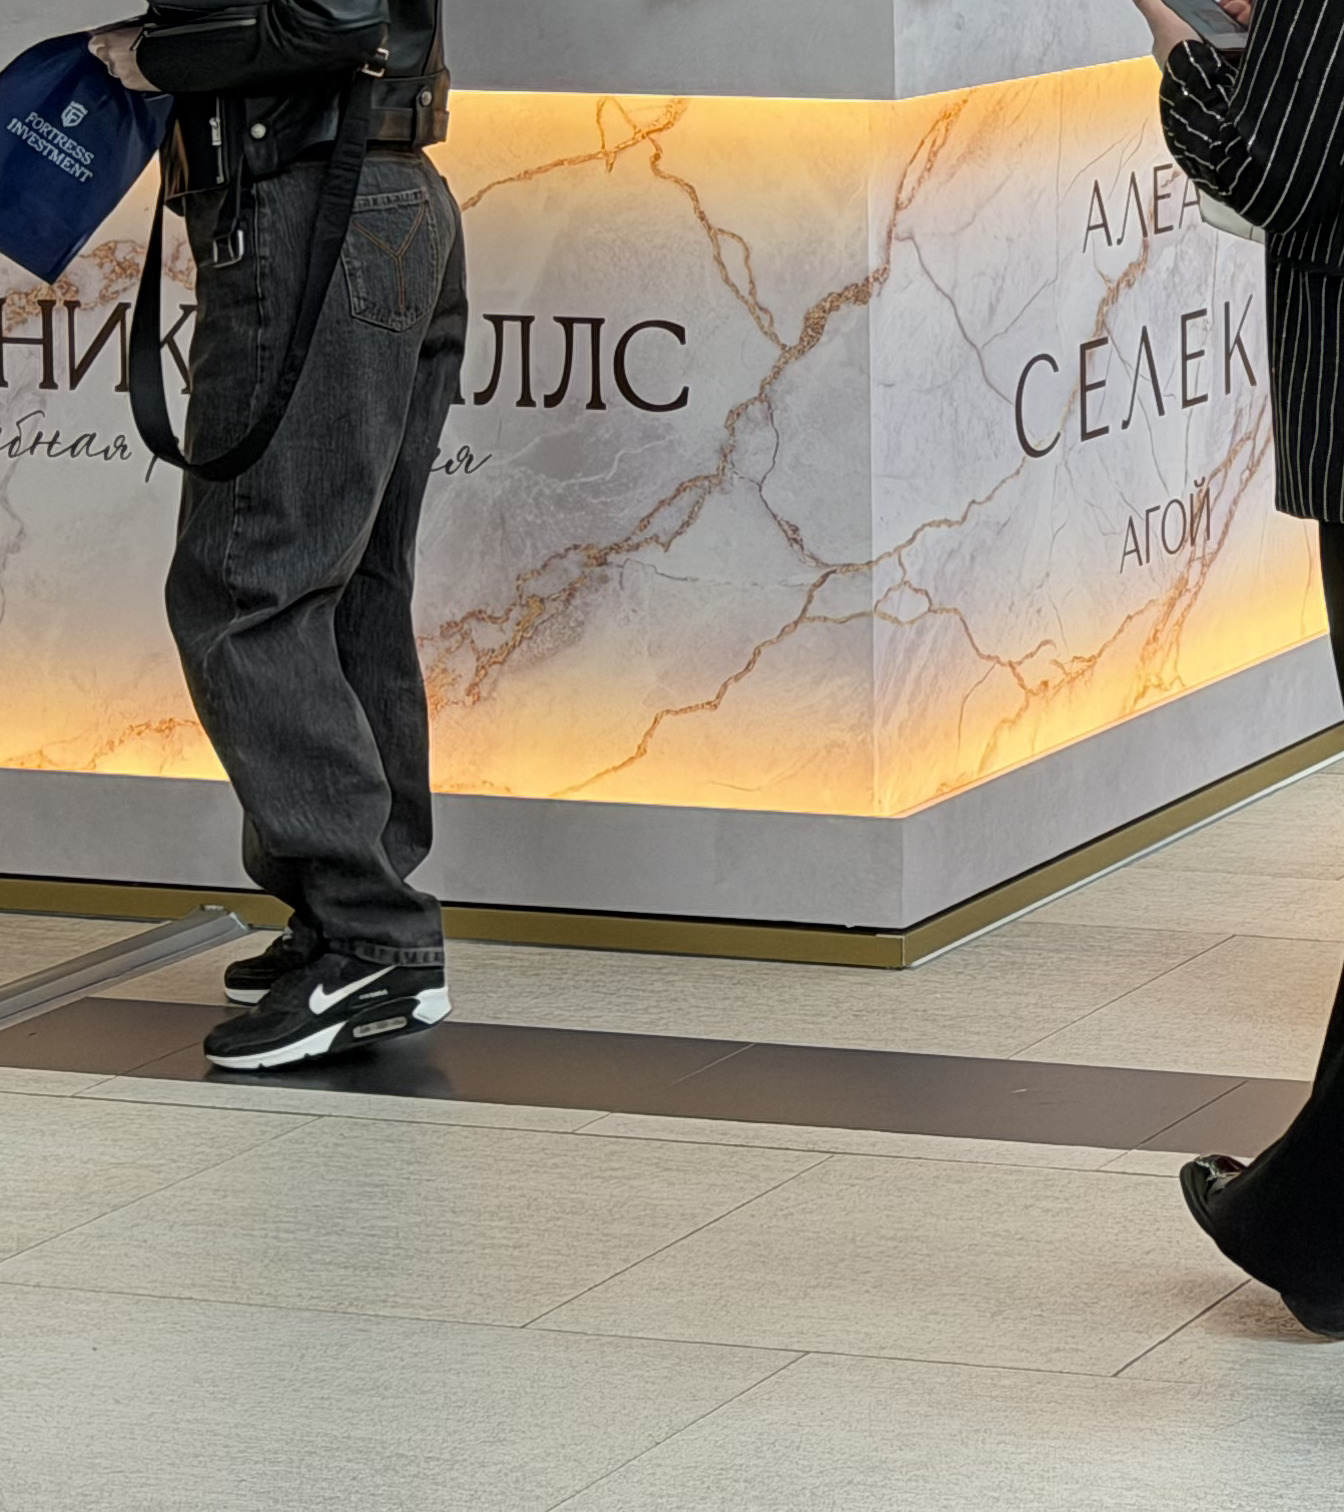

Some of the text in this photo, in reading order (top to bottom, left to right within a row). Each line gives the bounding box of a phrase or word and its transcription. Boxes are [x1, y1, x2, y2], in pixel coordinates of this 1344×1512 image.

[7, 118, 93, 182] INVESTMENT
[25, 112, 94, 165] FORTRESS
[451, 313, 690, 413] ЛЛС
[1015, 294, 1257, 458] СЕЛЕК
[0, 410, 132, 461] бная
[1120, 476, 1211, 575] АГОЙ
